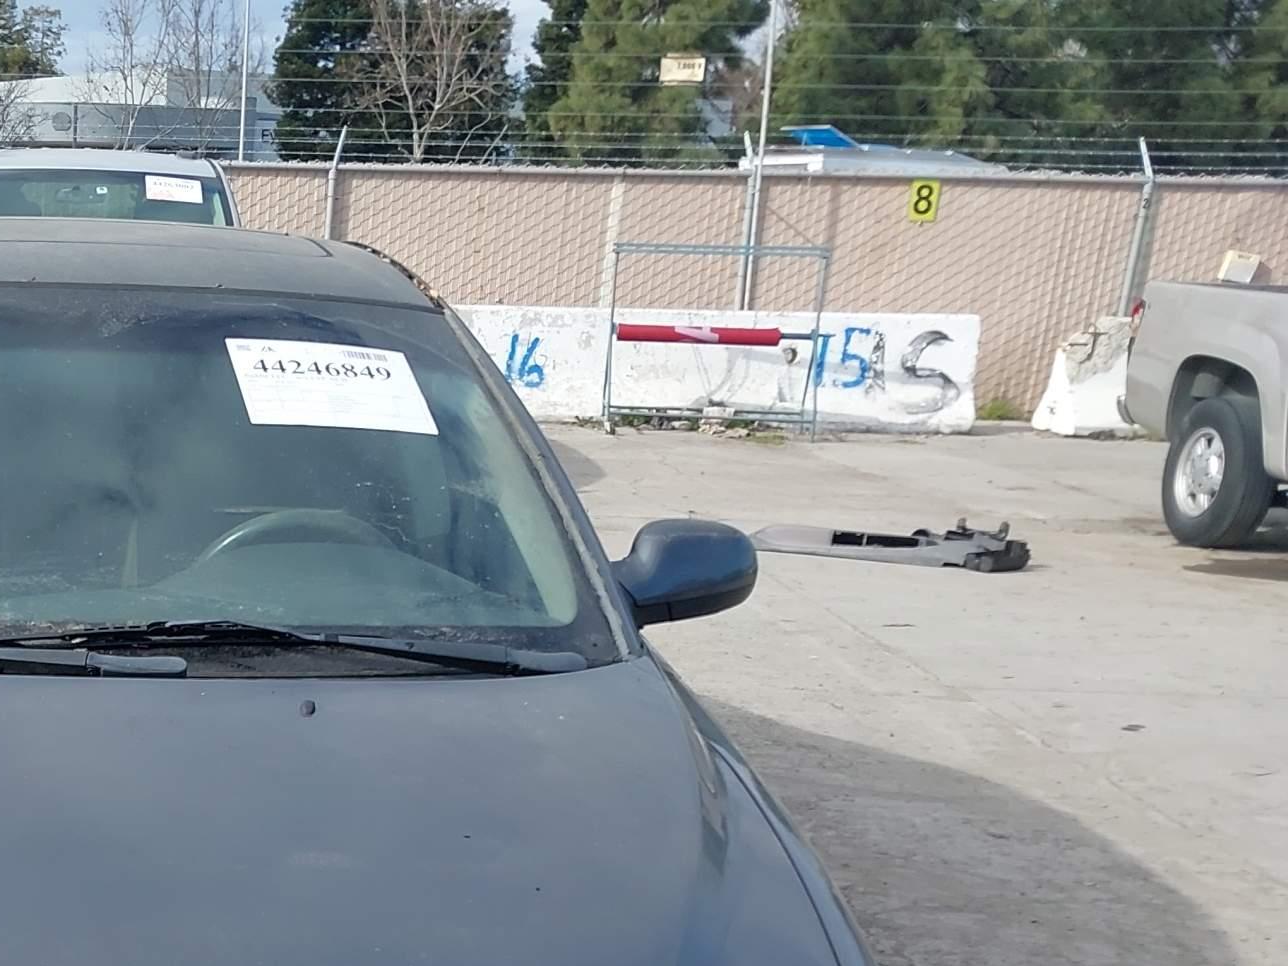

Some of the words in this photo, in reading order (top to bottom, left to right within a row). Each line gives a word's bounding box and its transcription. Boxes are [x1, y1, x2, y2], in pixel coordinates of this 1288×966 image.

[913, 184, 933, 214] 8
[253, 359, 391, 381] 44246849
[505, 334, 544, 388] 16
